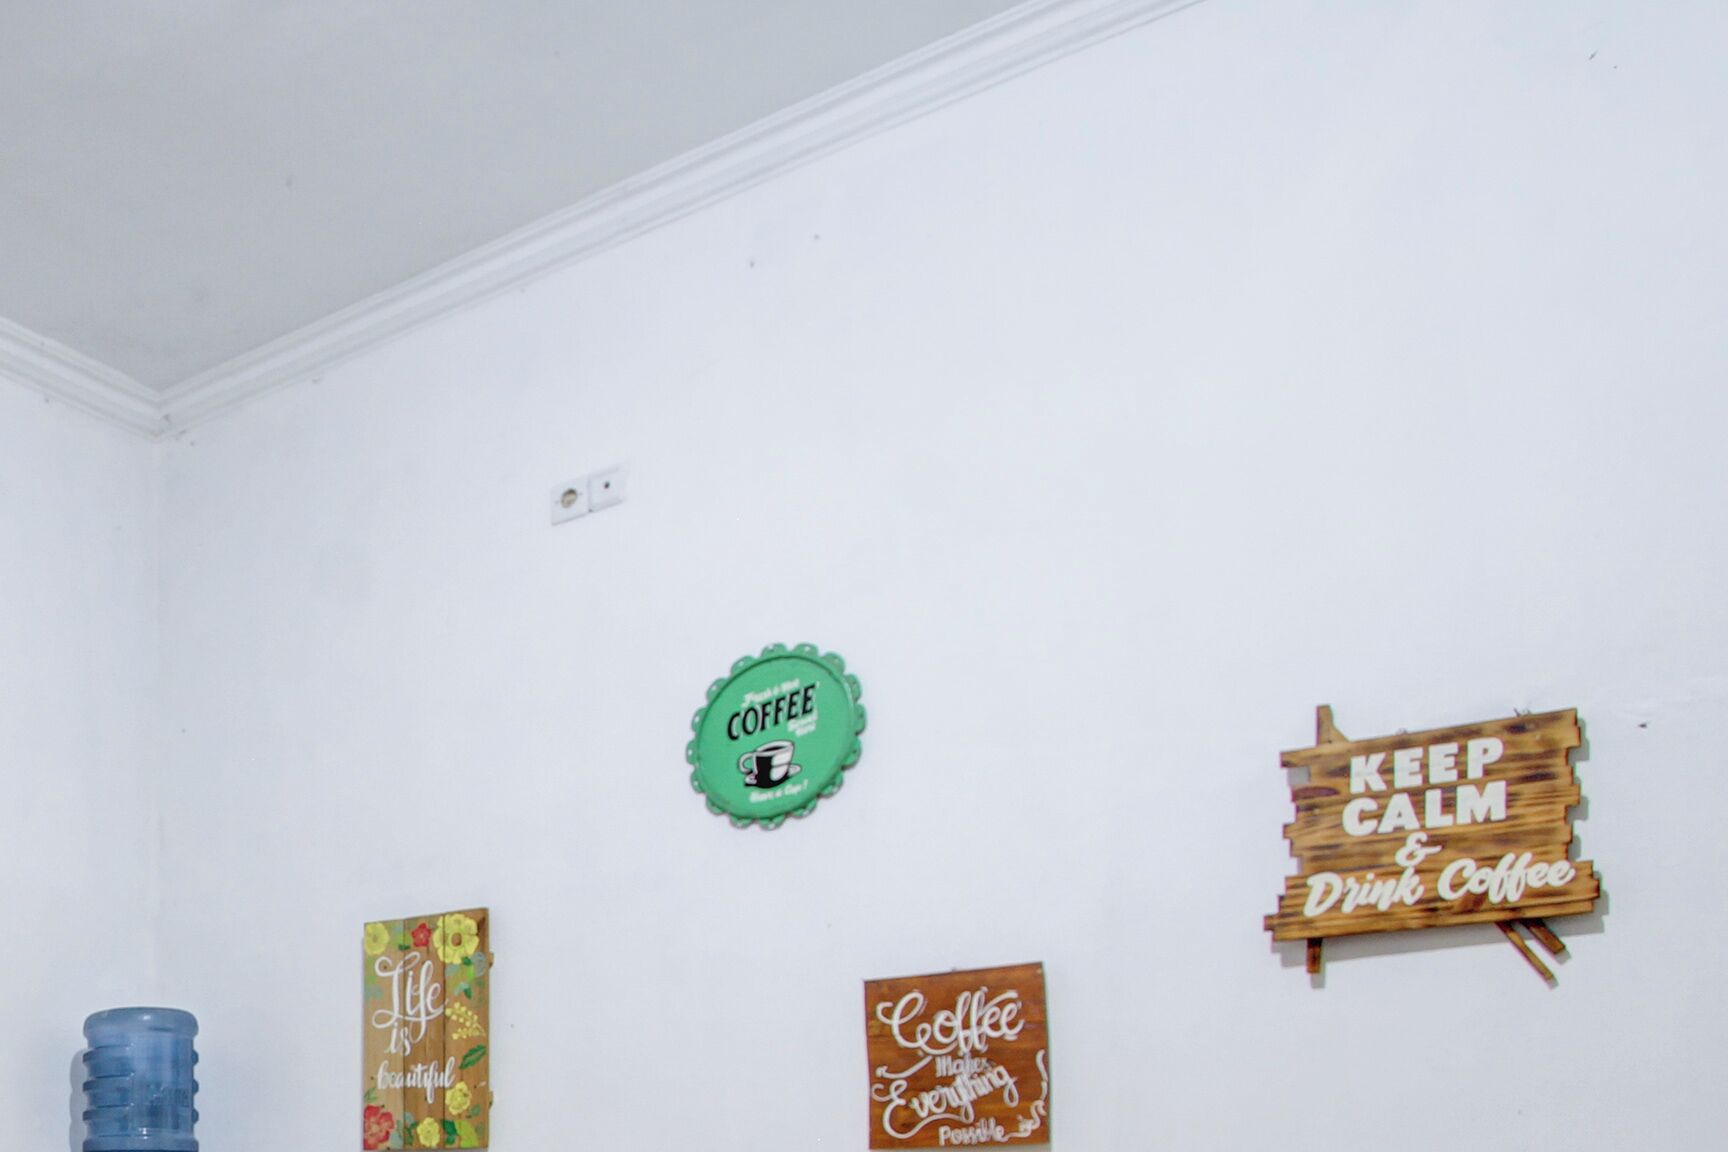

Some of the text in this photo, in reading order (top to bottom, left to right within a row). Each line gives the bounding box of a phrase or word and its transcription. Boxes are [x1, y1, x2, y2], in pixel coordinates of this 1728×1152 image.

[727, 683, 816, 740] COFFEE
[1349, 737, 1504, 794] KEEP
[1342, 780, 1507, 836] CALM
[1395, 832, 1442, 867] &
[1303, 852, 1576, 918] Drink Coffee
[372, 952, 448, 1043] Life
[876, 986, 1025, 1055] Coffee
[384, 1021, 411, 1056] is
[377, 1056, 456, 1104] beautiful
[871, 1065, 1020, 1139] Everything
[938, 1117, 1008, 1146] Possible
